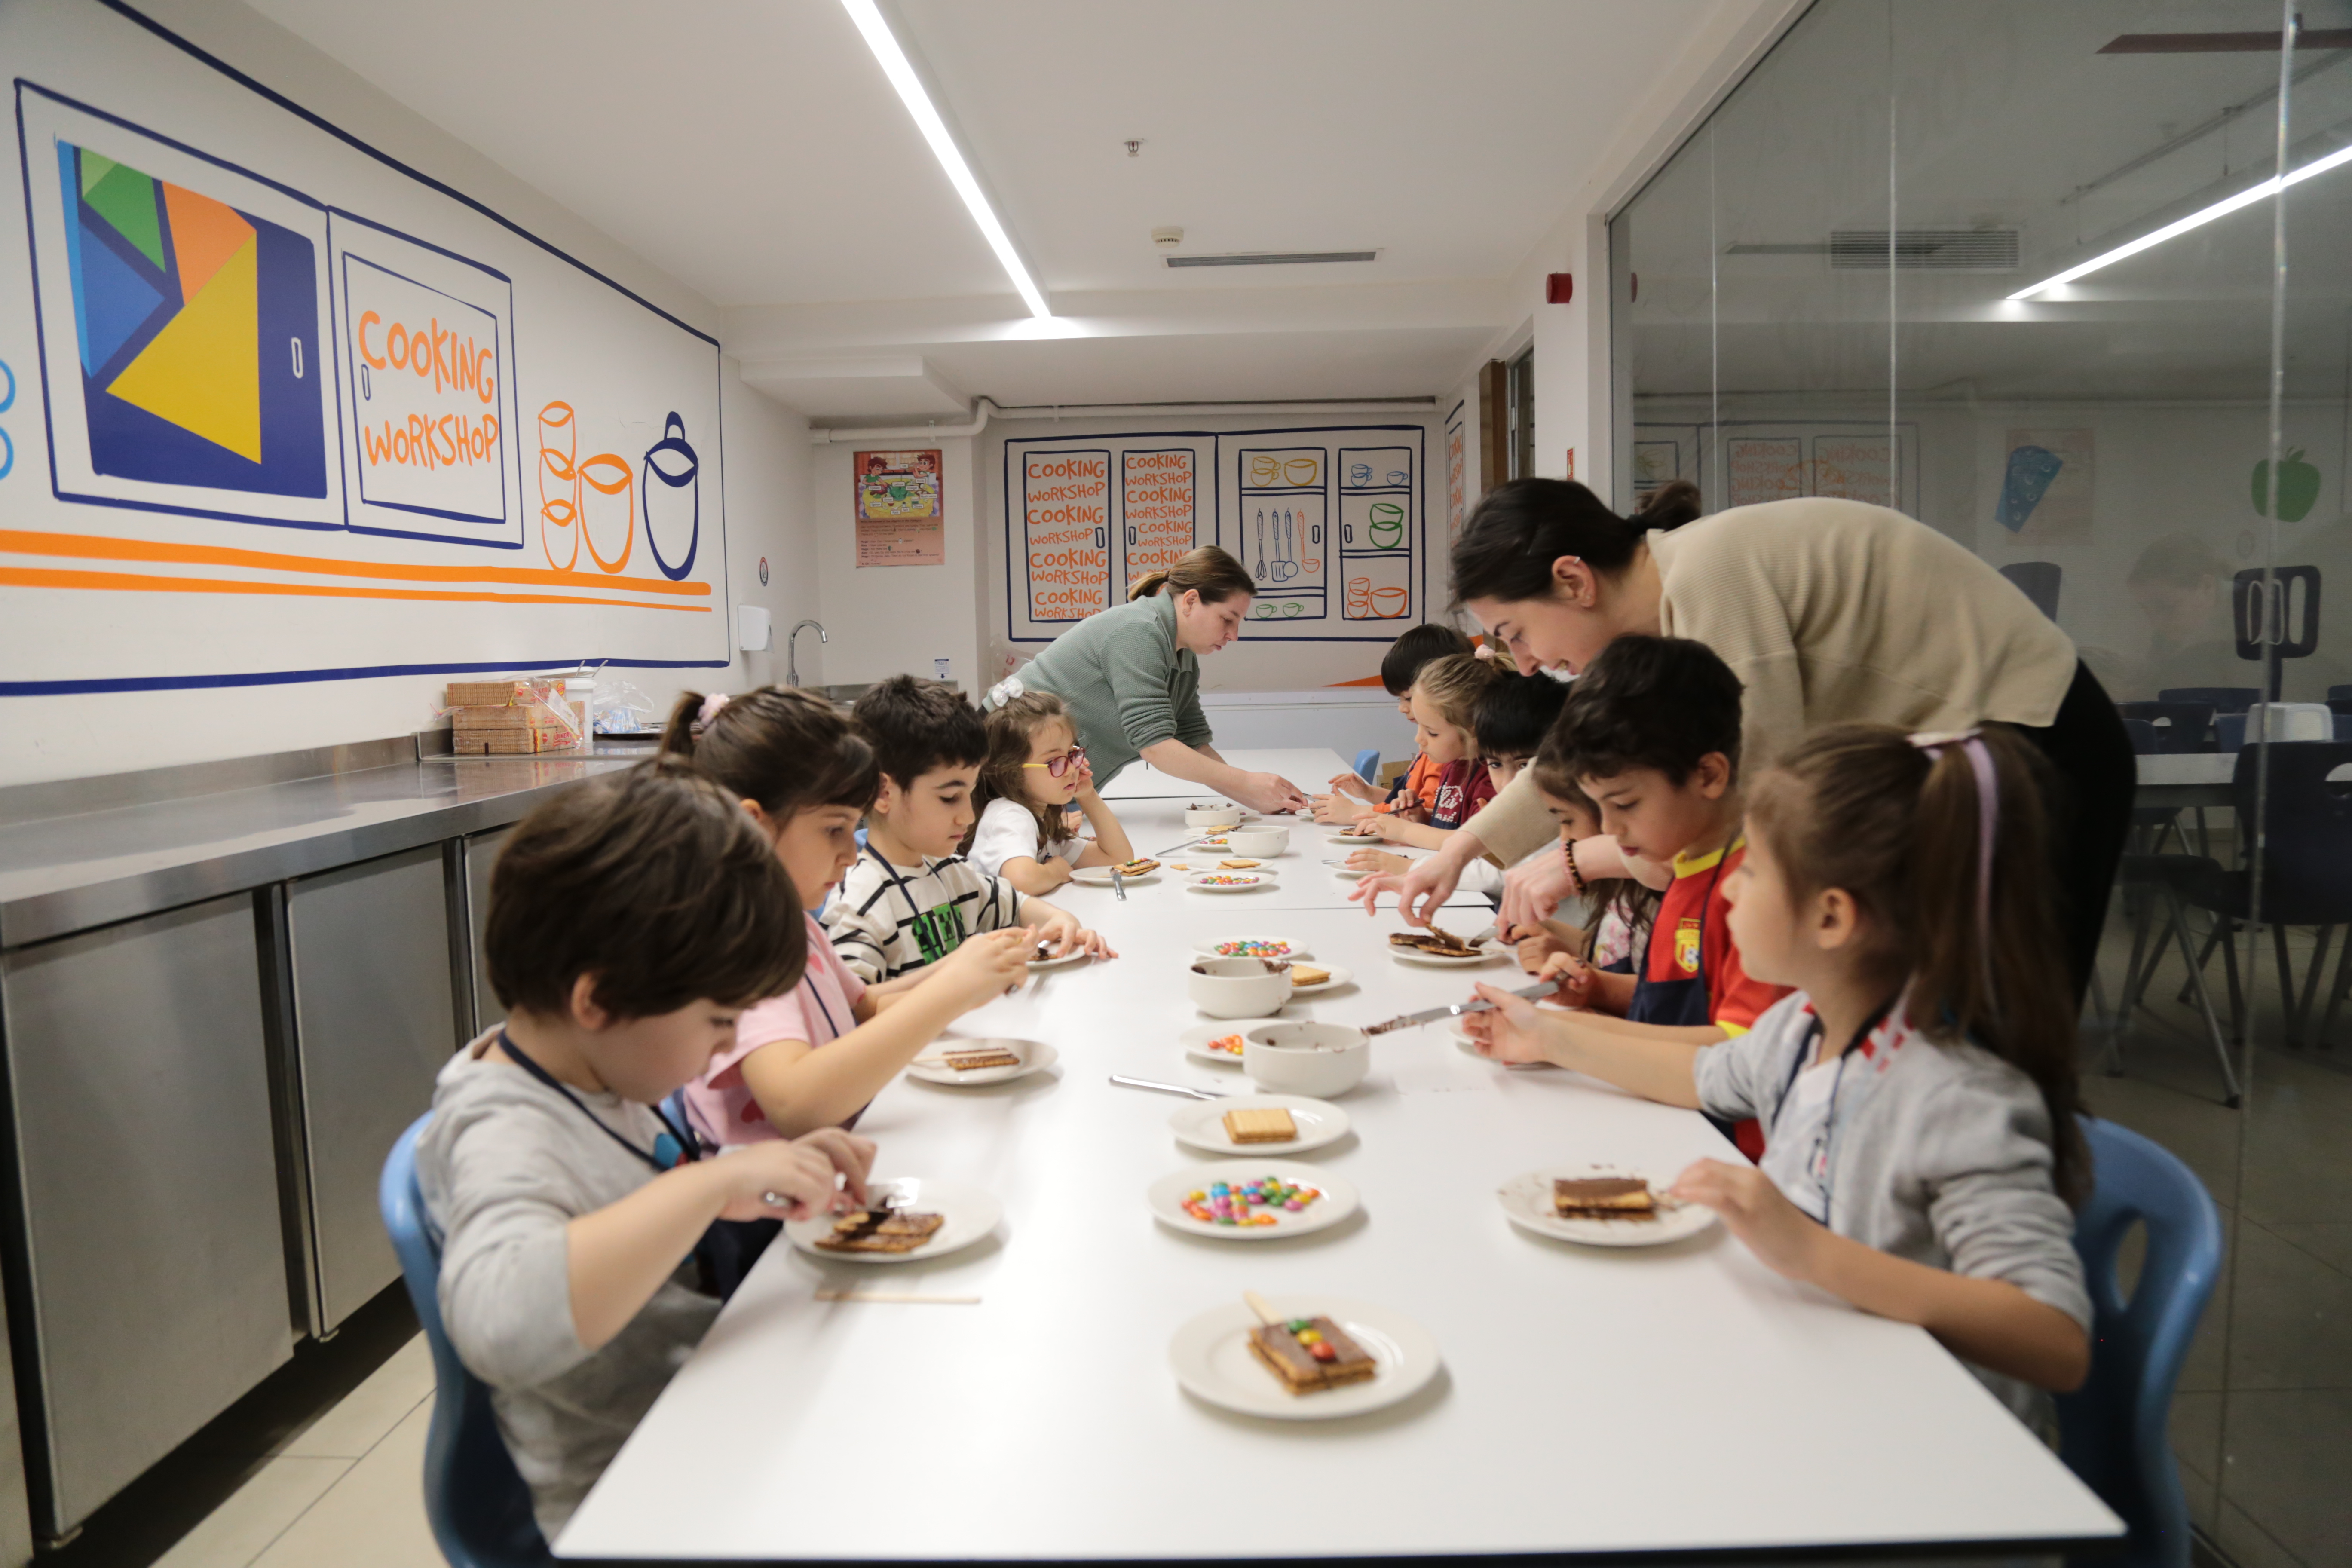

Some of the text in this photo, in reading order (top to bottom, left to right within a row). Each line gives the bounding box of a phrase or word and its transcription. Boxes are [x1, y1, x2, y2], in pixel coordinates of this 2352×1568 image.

[358, 310, 494, 404] COOKING
[364, 413, 499, 471] WORKSHOP
[1028, 458, 1105, 480] COOKING
[1126, 453, 1187, 470] COOKING
[1125, 471, 1193, 486] WORKSHOP
[1028, 481, 1106, 503] WORKSHOP
[1126, 486, 1192, 504] COOKING
[1027, 504, 1104, 526] COOKING
[1125, 504, 1192, 519] WORKSHOP
[1139, 520, 1193, 534] COOKING
[1030, 528, 1093, 545] WORKSHOP
[1138, 535, 1192, 547] WORKSHOP
[1030, 548, 1106, 569] COOKING
[1127, 548, 1191, 567] COOKIN
[1032, 569, 1109, 585] WORKSHOP
[1035, 588, 1103, 606] COOKING
